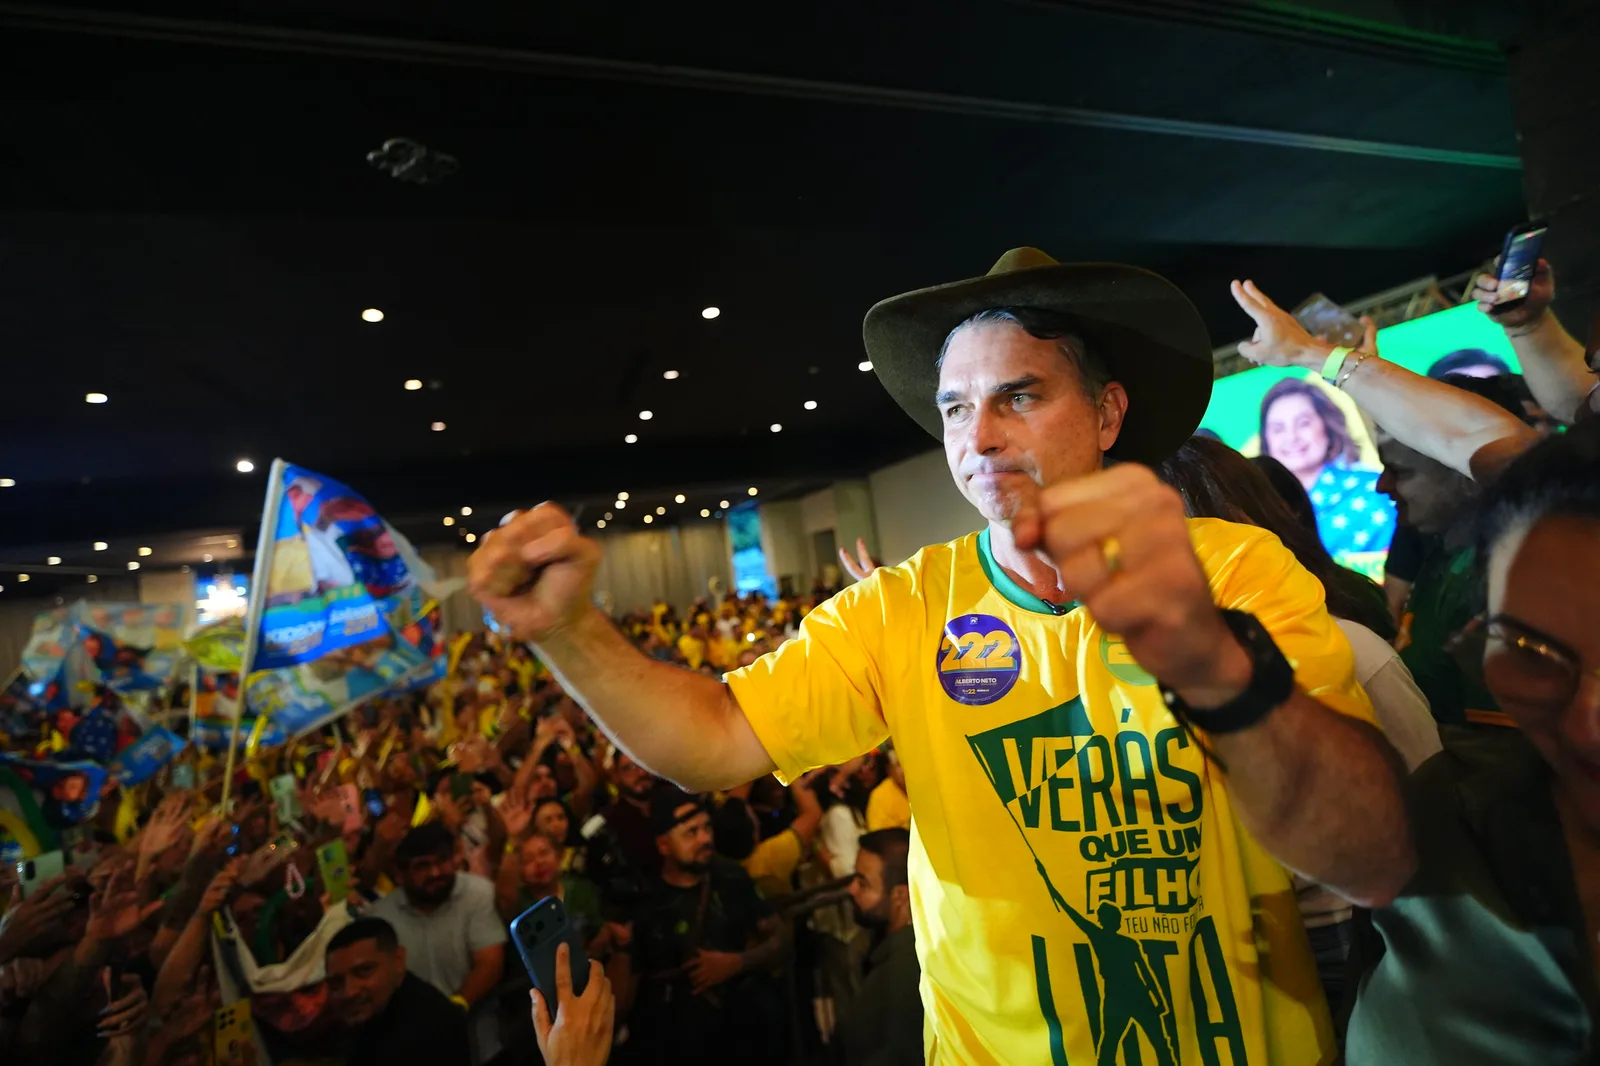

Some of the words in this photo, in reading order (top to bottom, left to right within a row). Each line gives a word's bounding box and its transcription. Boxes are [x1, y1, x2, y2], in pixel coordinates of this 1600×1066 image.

[941, 630, 1017, 673] 222
[1002, 708, 1203, 832] VERÁS
[1079, 829, 1152, 862] QUE
[1125, 917, 1148, 934] TEU
[1152, 914, 1180, 934] NÃO
